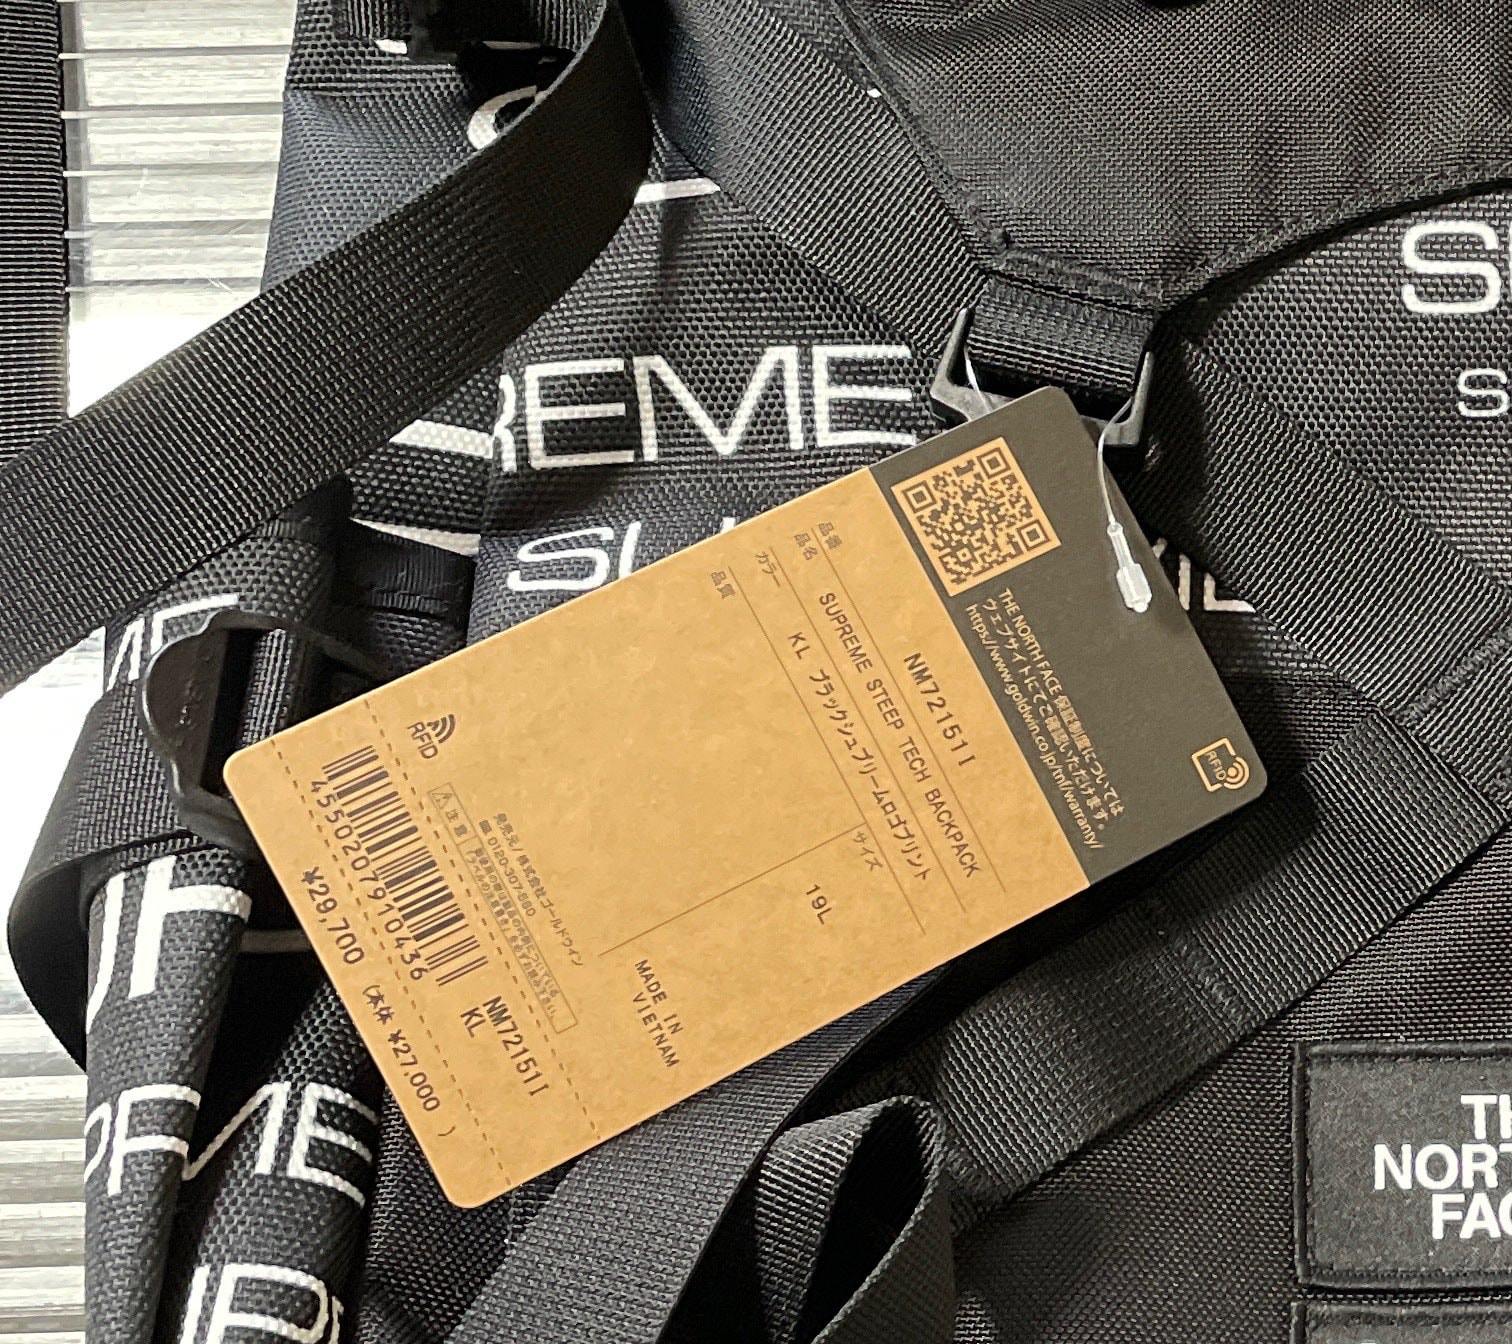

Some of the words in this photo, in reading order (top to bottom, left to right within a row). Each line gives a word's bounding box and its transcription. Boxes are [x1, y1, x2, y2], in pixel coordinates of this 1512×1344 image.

[792, 532, 818, 561] 品名
[754, 550, 781, 588] カラー
[786, 631, 811, 660] KL
[997, 586, 1020, 616] THE
[1011, 614, 1045, 661] NORTH
[1035, 659, 1063, 695] FACE
[405, 720, 438, 759] RFID
[818, 591, 873, 674] SUPREME
[865, 677, 905, 730] STEEP
[897, 735, 932, 783] TECH
[923, 787, 981, 878] BACKPACK
[1204, 750, 1228, 780] RFID
[851, 830, 883, 872] サイズ
[310, 773, 429, 981] 4550207910436
[299, 865, 365, 965] ¥29,700
[805, 883, 832, 925] 19L
[634, 958, 667, 1004] MADE
[662, 1012, 684, 1035] IN
[459, 1006, 486, 1038] KL
[631, 991, 680, 1067] VIETNAM
